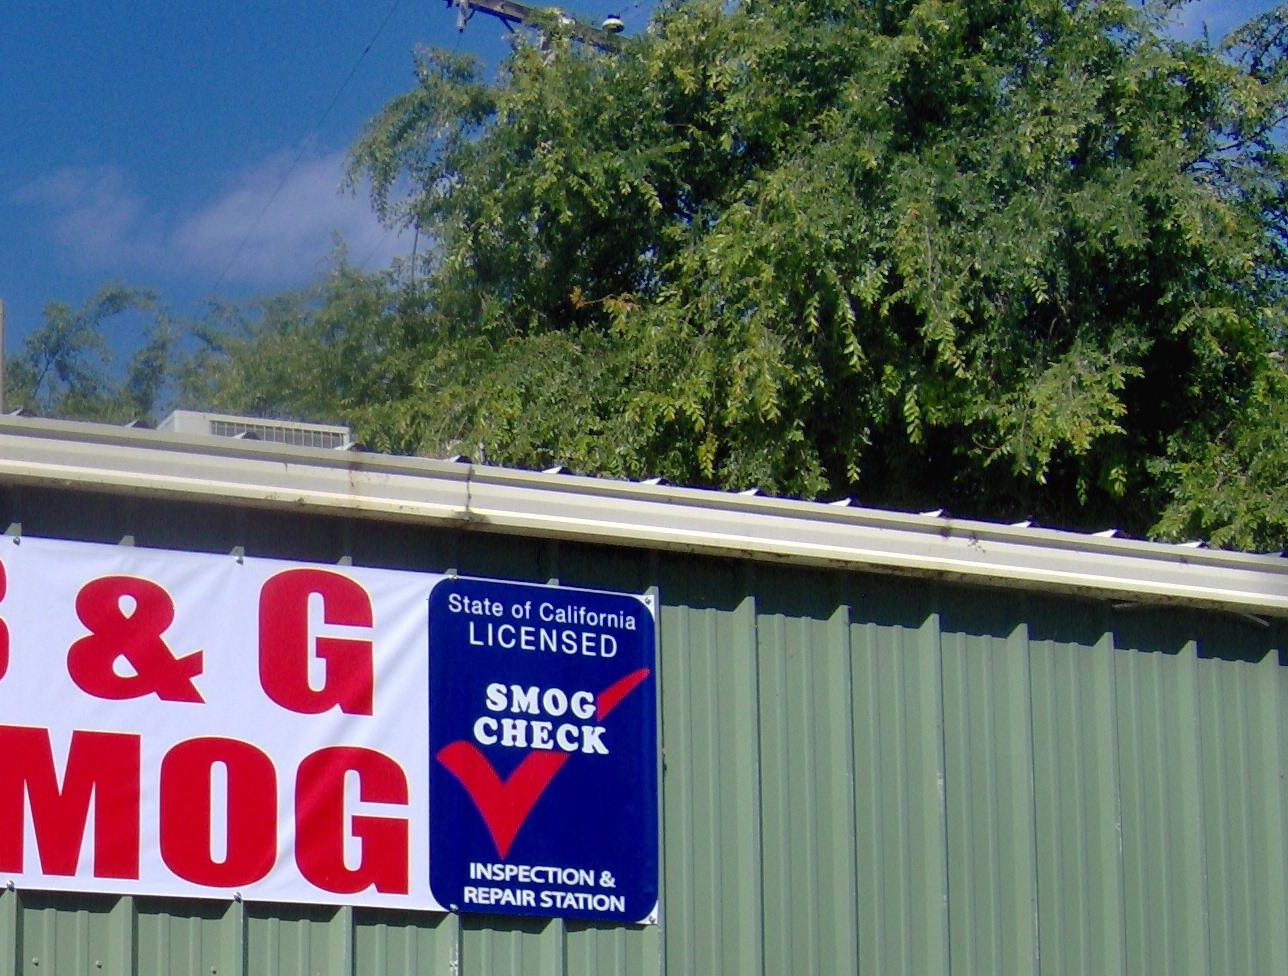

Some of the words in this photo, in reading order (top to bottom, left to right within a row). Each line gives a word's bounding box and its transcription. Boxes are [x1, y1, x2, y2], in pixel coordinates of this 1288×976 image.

[448, 592, 504, 618] State
[511, 597, 532, 620] of
[538, 601, 636, 631] California
[66, 574, 206, 704] &
[258, 567, 374, 717] G
[469, 621, 618, 658] LICENSED
[486, 682, 596, 720] SMOG
[473, 716, 609, 755] CHECK
[469, 862, 595, 887] INSPECTION
[599, 870, 616, 889] &
[463, 886, 536, 908] REPAIR
[541, 890, 626, 913] STATION
